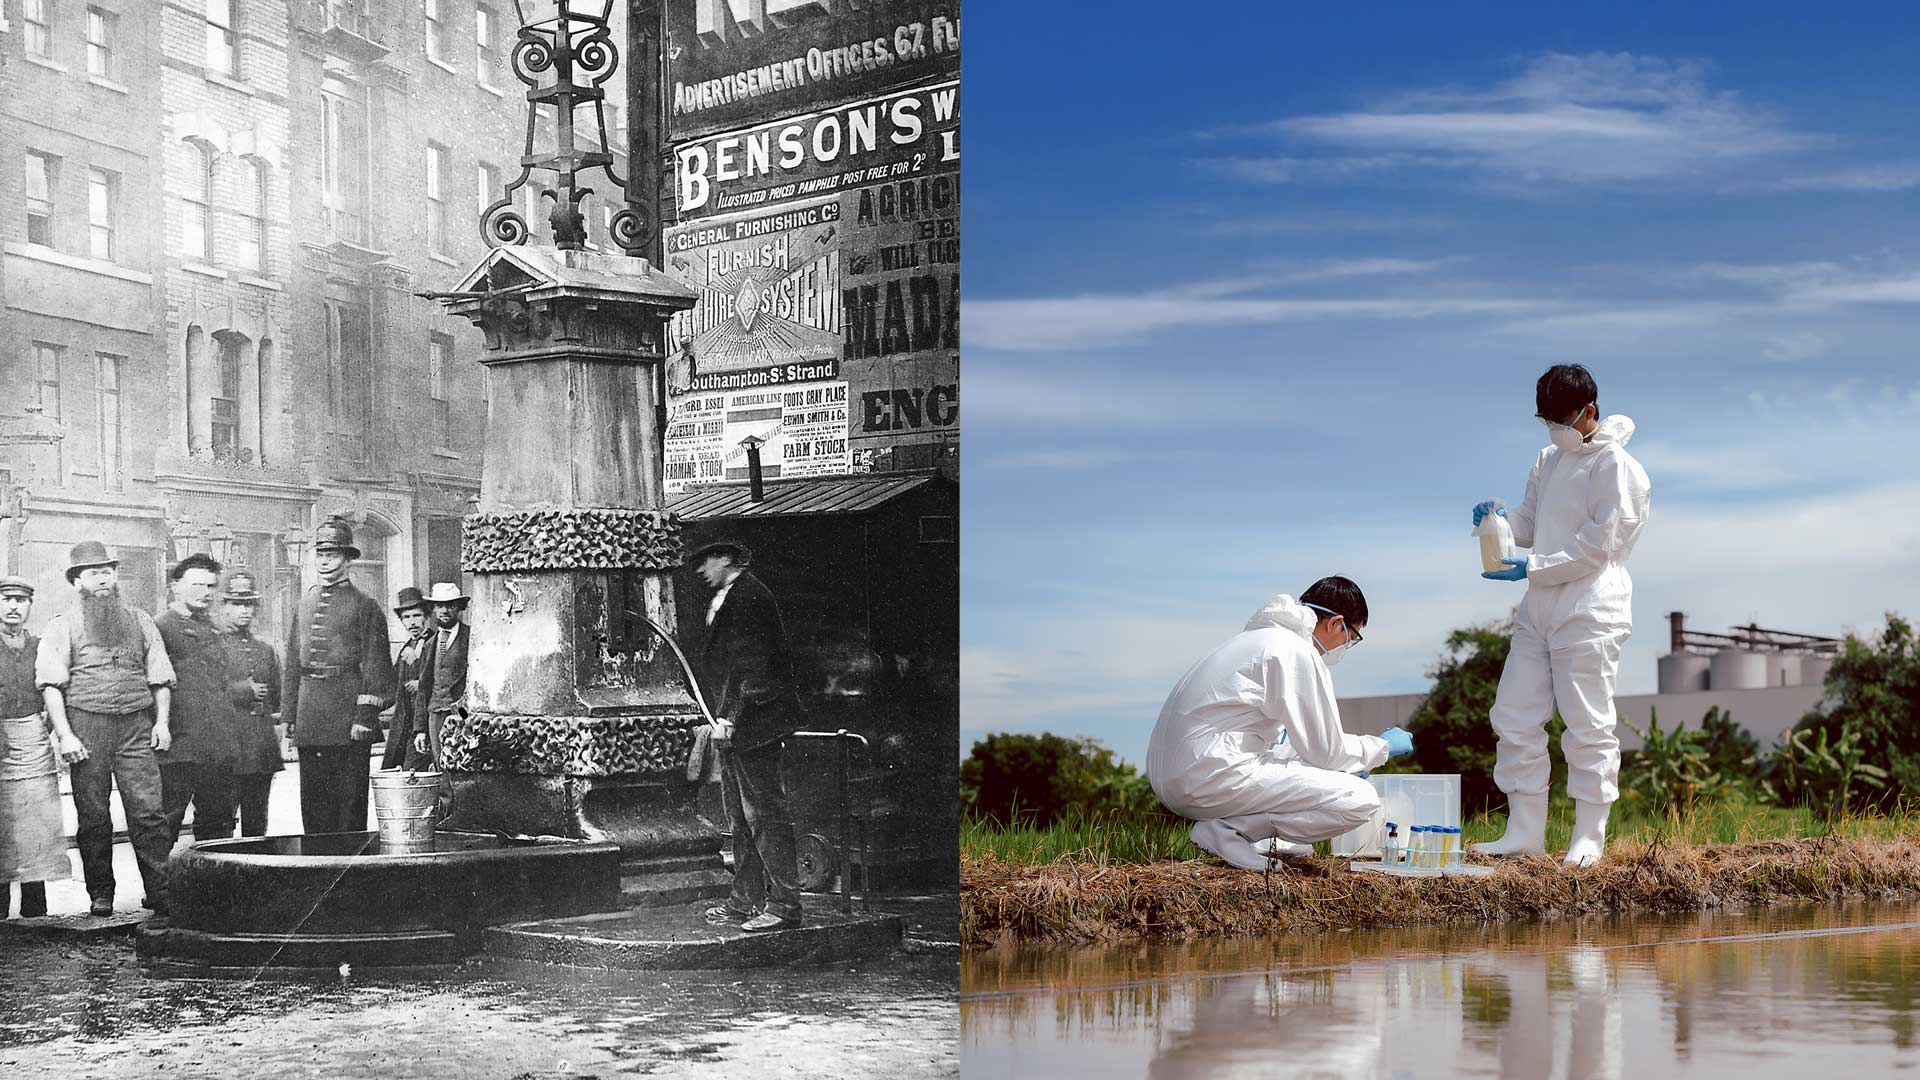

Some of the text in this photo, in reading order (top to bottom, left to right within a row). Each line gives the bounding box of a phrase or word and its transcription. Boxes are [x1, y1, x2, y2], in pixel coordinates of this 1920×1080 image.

[674, 58, 806, 116] ADVERTISEMENT
[931, 16, 960, 54] FL
[679, 97, 922, 212] BENSON'S
[717, 190, 767, 209] ILLUSTRATED
[769, 184, 796, 200] PRICED
[798, 174, 840, 194] PAMPHLET
[842, 170, 865, 186] POST
[867, 165, 888, 180] FREE
[890, 162, 909, 176] FOR
[677, 228, 731, 250] GENERAL
[736, 211, 817, 239] FURNISHING
[707, 233, 789, 286] FURNISH
[703, 250, 840, 335] HIRE SYSTEM
[787, 362, 836, 382] Strand.
[732, 393, 782, 407] AMERICAN LINE
[783, 391, 804, 407] FOOTS
[825, 386, 846, 402] PLACE
[807, 411, 829, 423] SMITH
[669, 454, 688, 462] LIVE
[698, 451, 720, 461] DEAD
[783, 439, 846, 458] FARM STOCK
[700, 459, 723, 477] STOCK
